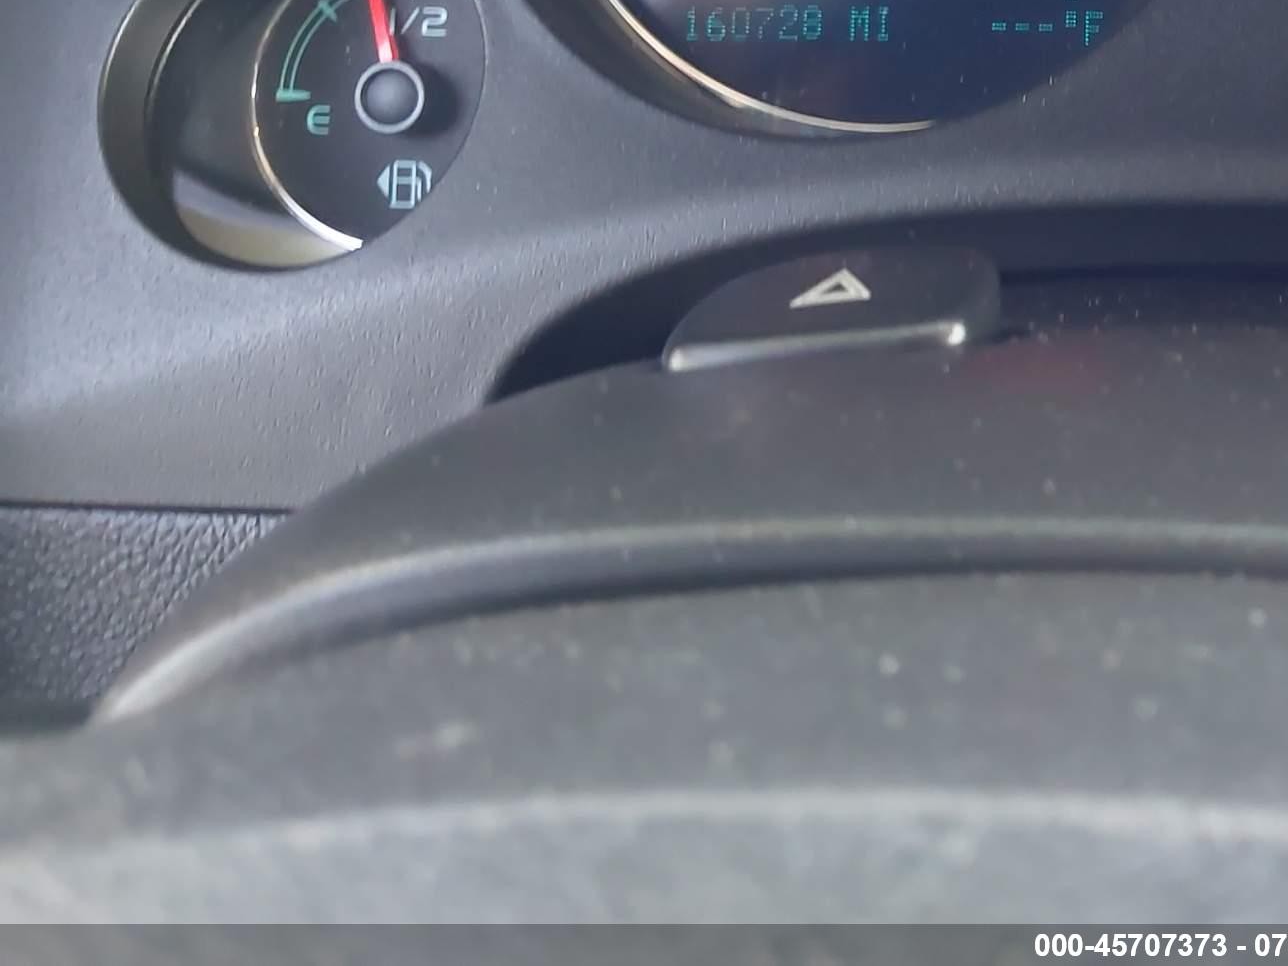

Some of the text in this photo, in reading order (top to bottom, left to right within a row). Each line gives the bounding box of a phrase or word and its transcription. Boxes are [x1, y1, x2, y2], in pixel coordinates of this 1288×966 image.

[686, 5, 889, 42] 160728 MI
[305, 105, 331, 134] E
